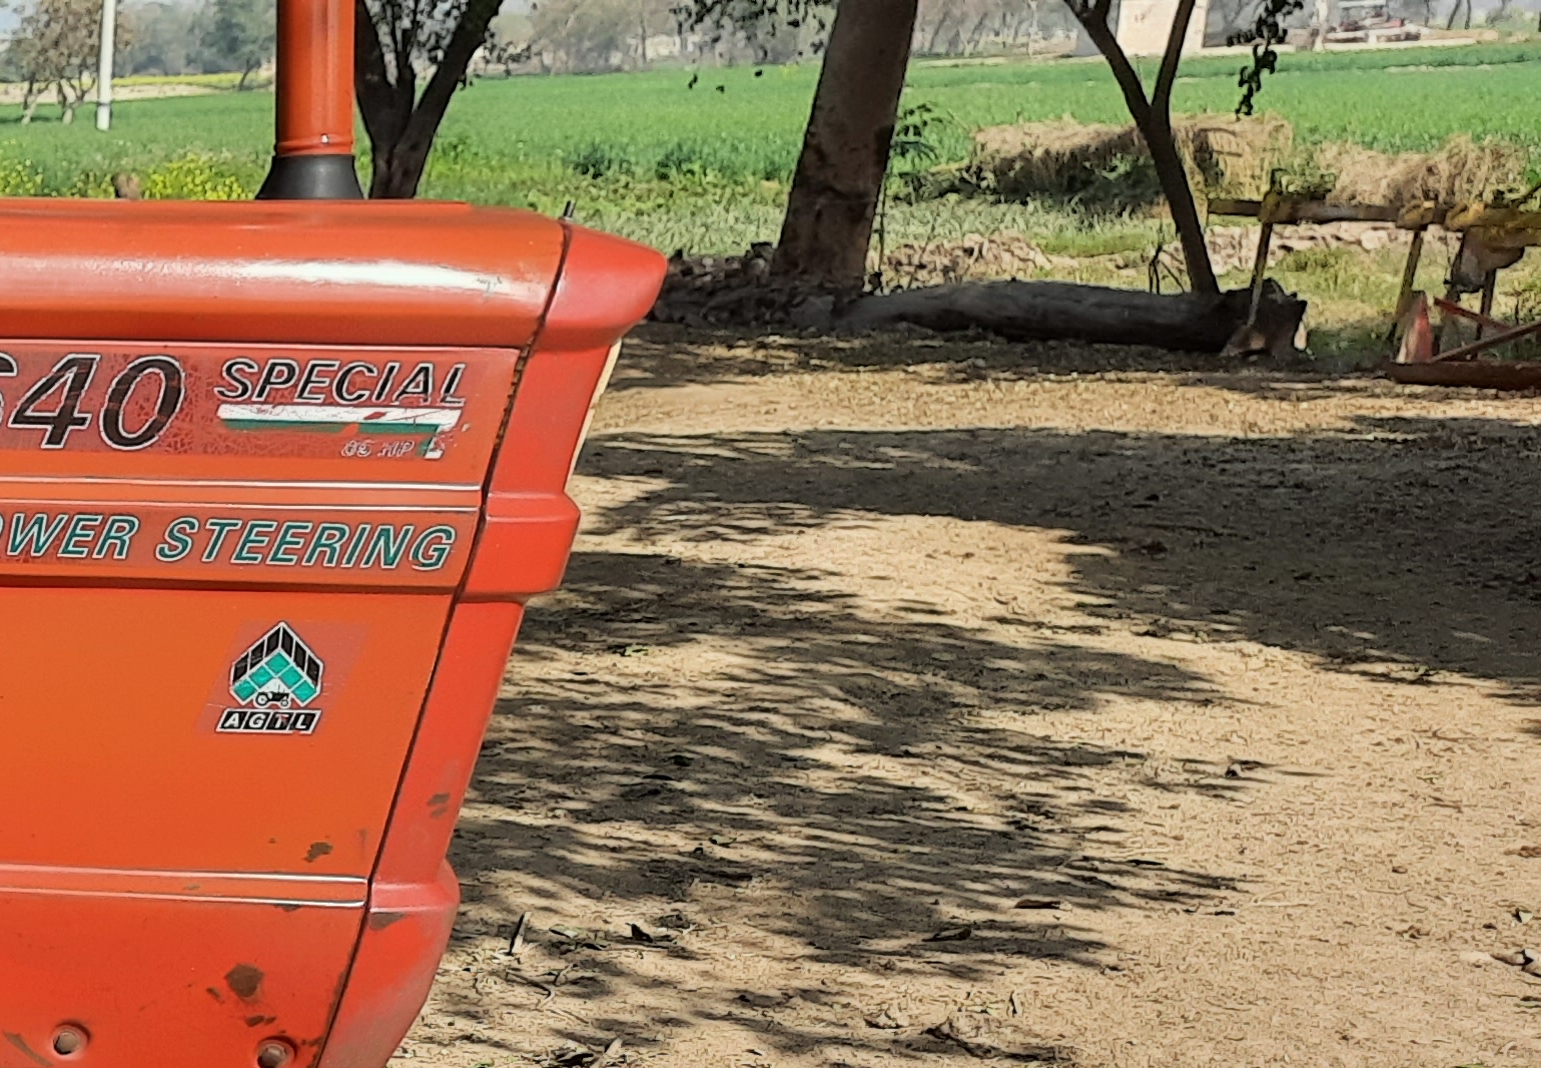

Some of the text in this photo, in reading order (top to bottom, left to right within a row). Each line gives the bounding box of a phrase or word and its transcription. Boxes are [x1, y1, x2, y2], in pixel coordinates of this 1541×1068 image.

[213, 357, 467, 406] SPECIAL
[153, 515, 458, 572] STEERING
[216, 708, 321, 734] AGTL
